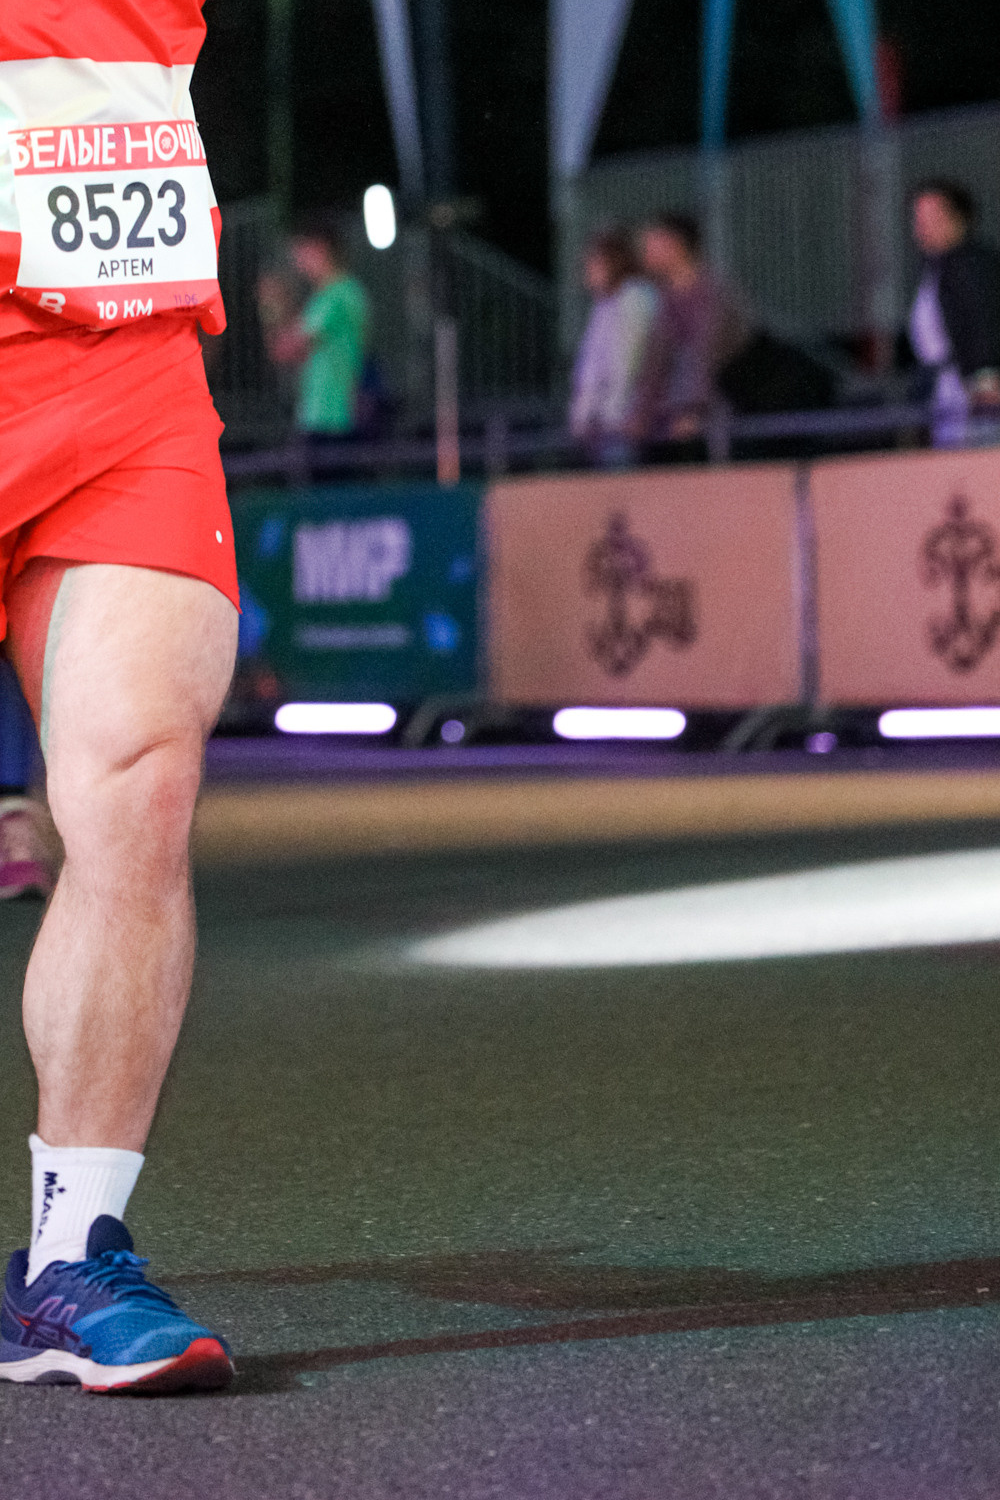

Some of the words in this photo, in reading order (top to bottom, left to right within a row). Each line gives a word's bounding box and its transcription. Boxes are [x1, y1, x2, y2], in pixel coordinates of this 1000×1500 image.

[10, 127, 116, 169] БЕЛЫЕ
[125, 123, 206, 164] НОЧИ
[47, 179, 187, 252] 8523
[97, 257, 154, 279] АРТЕМ
[97, 300, 118, 320] 10
